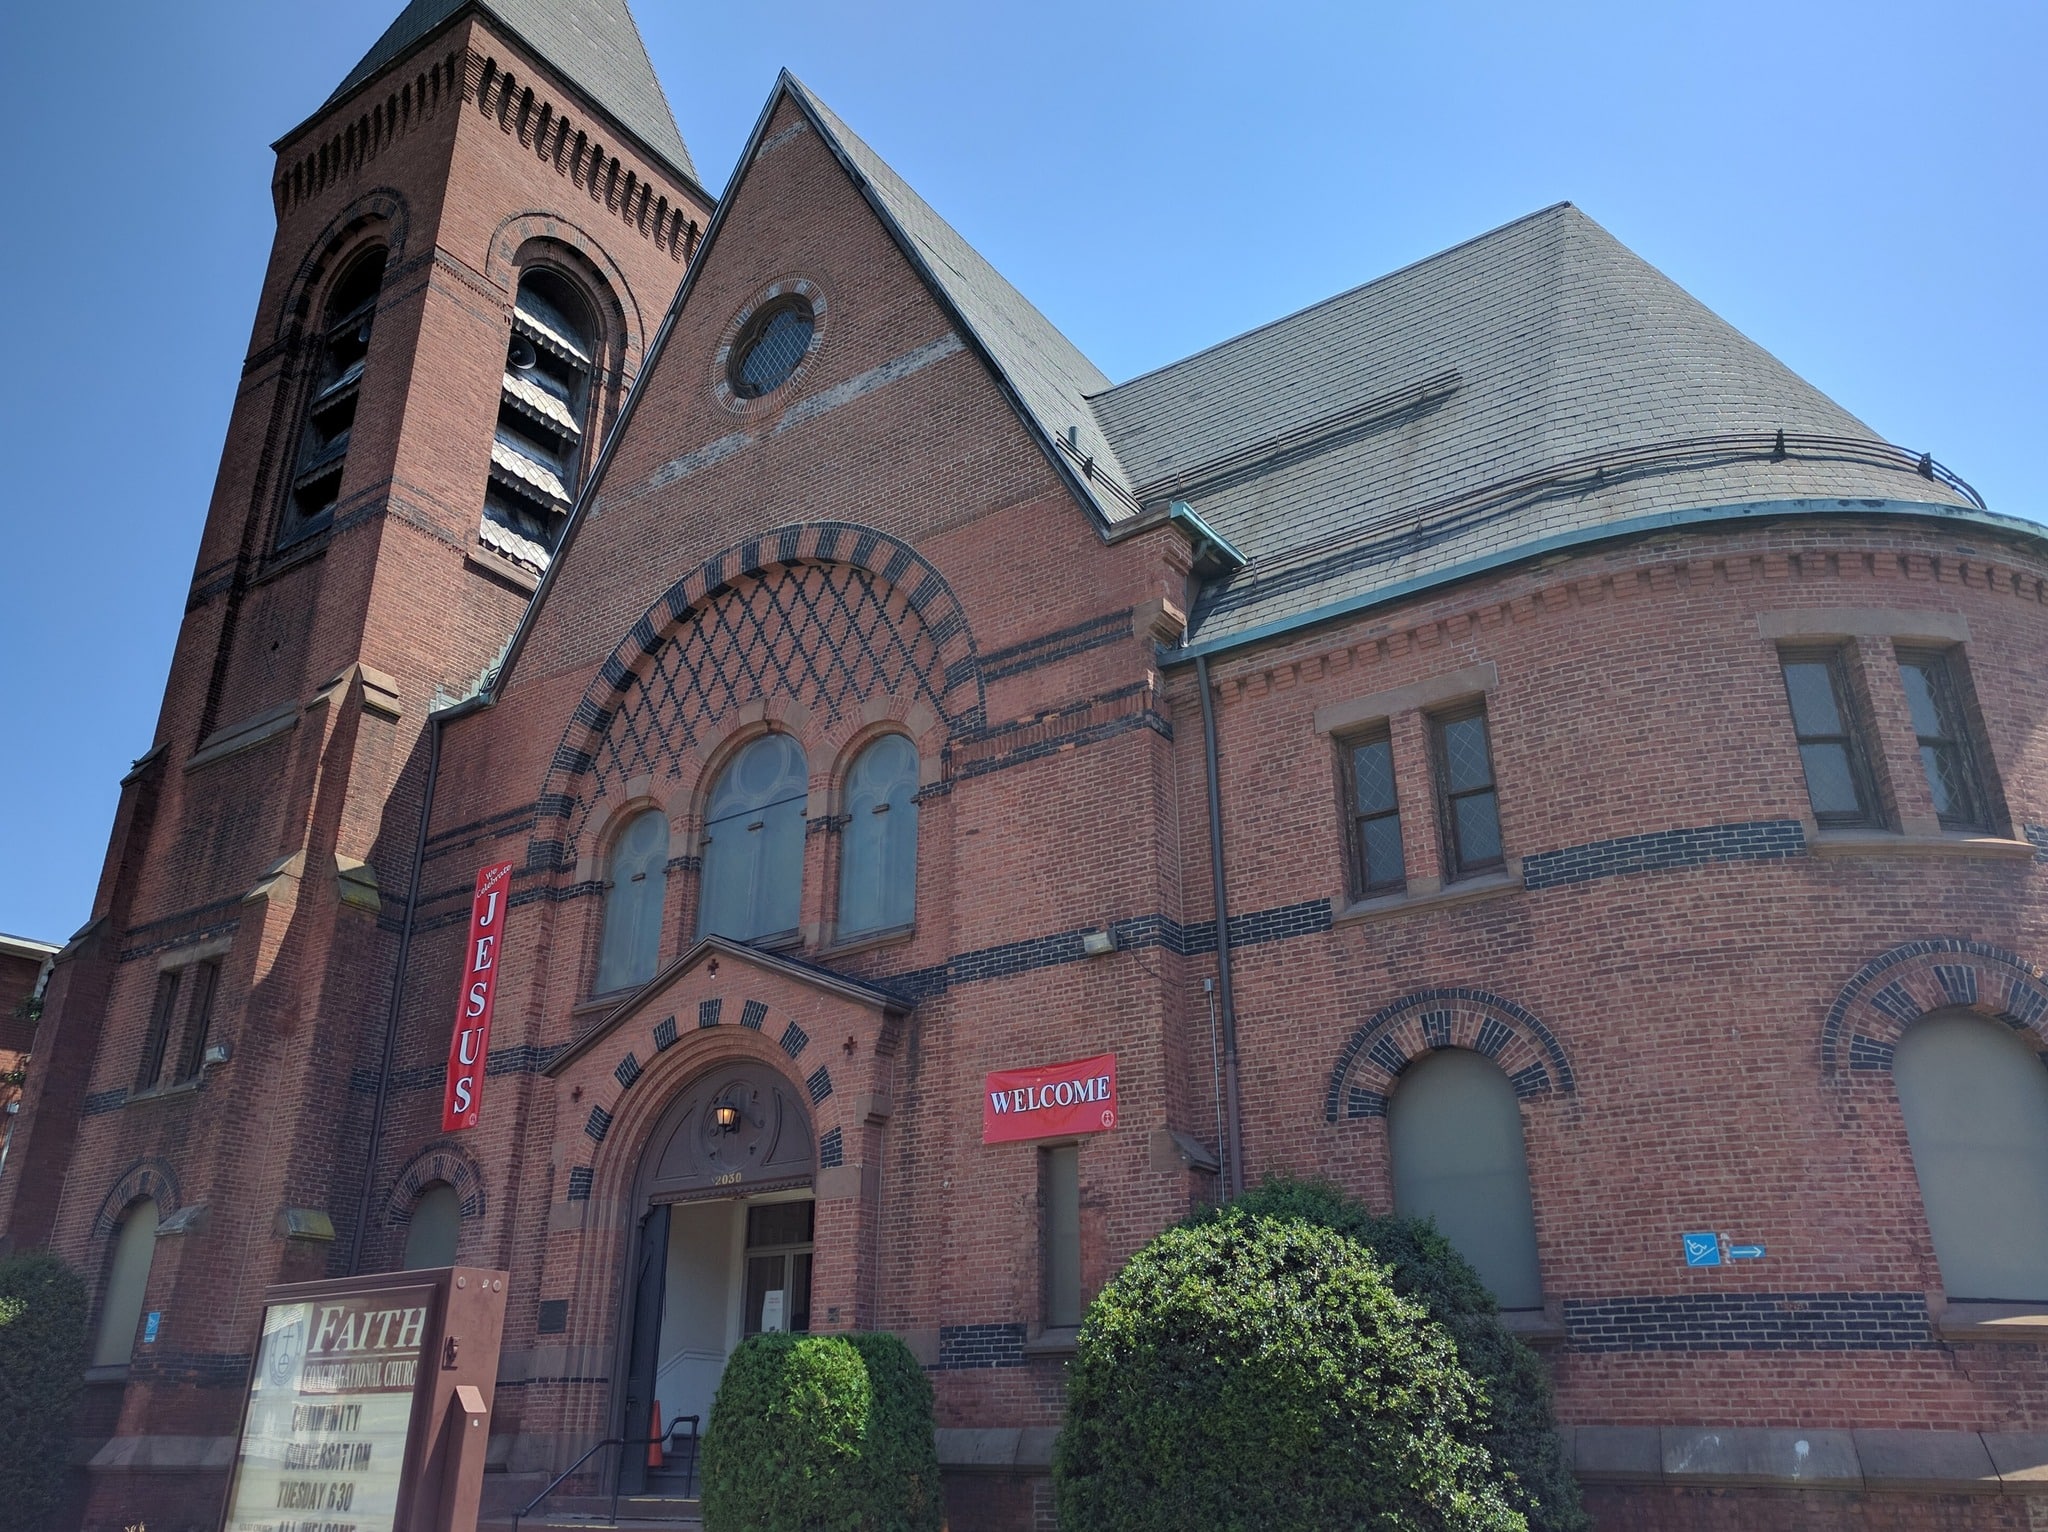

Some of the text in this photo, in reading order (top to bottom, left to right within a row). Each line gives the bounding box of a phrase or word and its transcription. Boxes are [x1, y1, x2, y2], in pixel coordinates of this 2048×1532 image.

[485, 868, 498, 880] We
[453, 891, 499, 1114] JESUS
[990, 1076, 1111, 1114] WELCOME
[715, 1172, 742, 1186] 2030
[308, 1306, 427, 1353] FAITH
[302, 1360, 418, 1390] CONGREGATIONAL CHURC
[292, 1405, 362, 1432] COMMUNITY
[284, 1442, 372, 1471] CONVERSATION
[277, 1481, 326, 1510] TUESDAY
